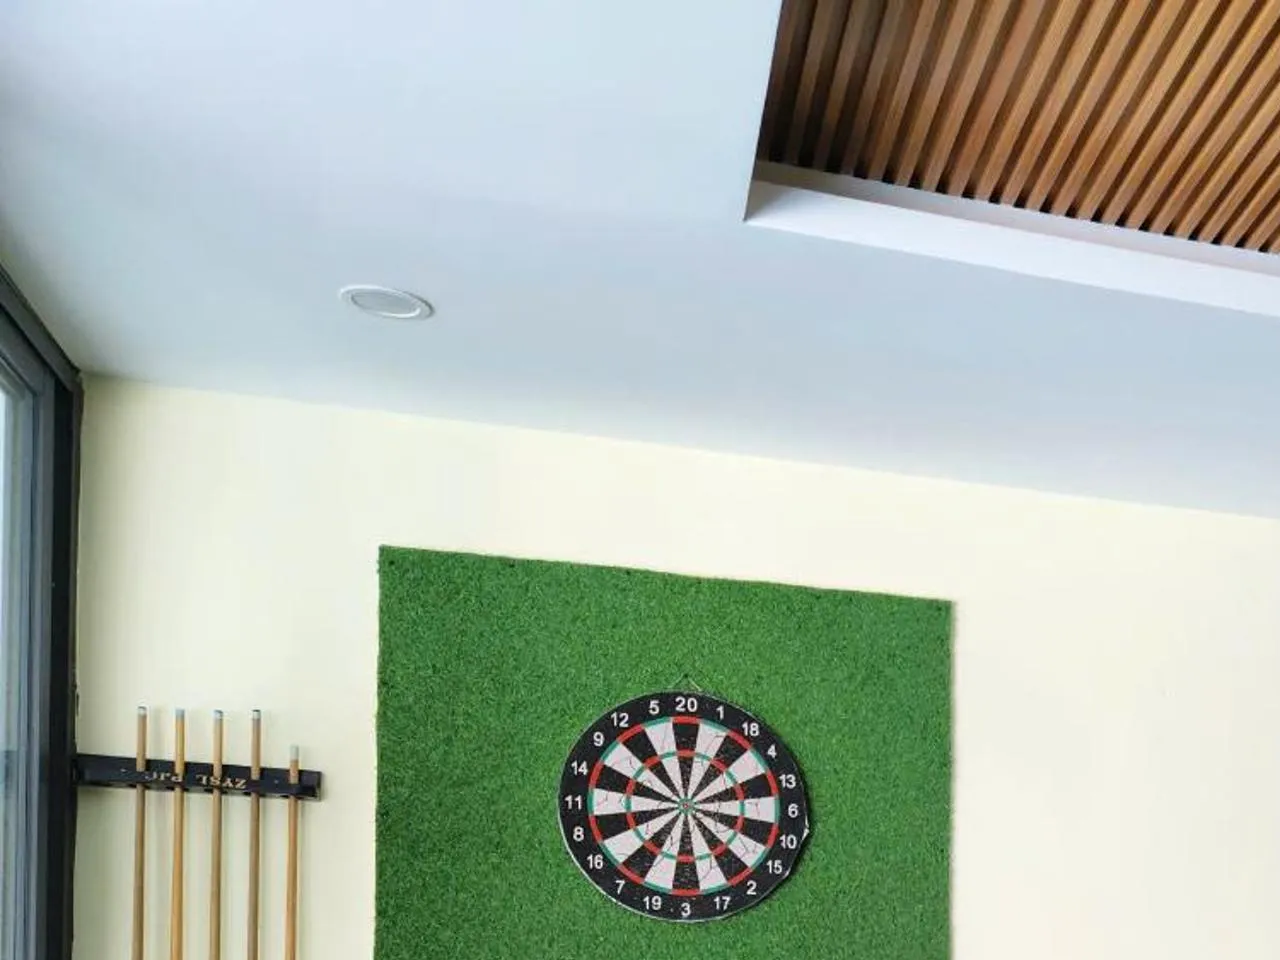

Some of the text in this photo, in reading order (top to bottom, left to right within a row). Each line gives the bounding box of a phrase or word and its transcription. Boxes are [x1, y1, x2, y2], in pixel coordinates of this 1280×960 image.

[649, 700, 660, 715] 5
[675, 696, 697, 712] 20
[611, 712, 629, 727] 12
[716, 705, 725, 719] 1
[742, 722, 759, 736] 18
[593, 732, 604, 747] 9
[767, 745, 777, 759] 4
[571, 761, 588, 775] 14
[779, 774, 796, 788] 13
[564, 795, 583, 810] 11
[788, 803, 798, 818] 6
[573, 826, 584, 841] 8
[779, 835, 797, 849] 10
[586, 854, 603, 869] 16
[767, 860, 783, 874] 15
[615, 880, 626, 895] 7
[746, 880, 757, 895] 2
[643, 896, 662, 910] 19
[681, 902, 691, 917] 3
[713, 896, 731, 910] 17
